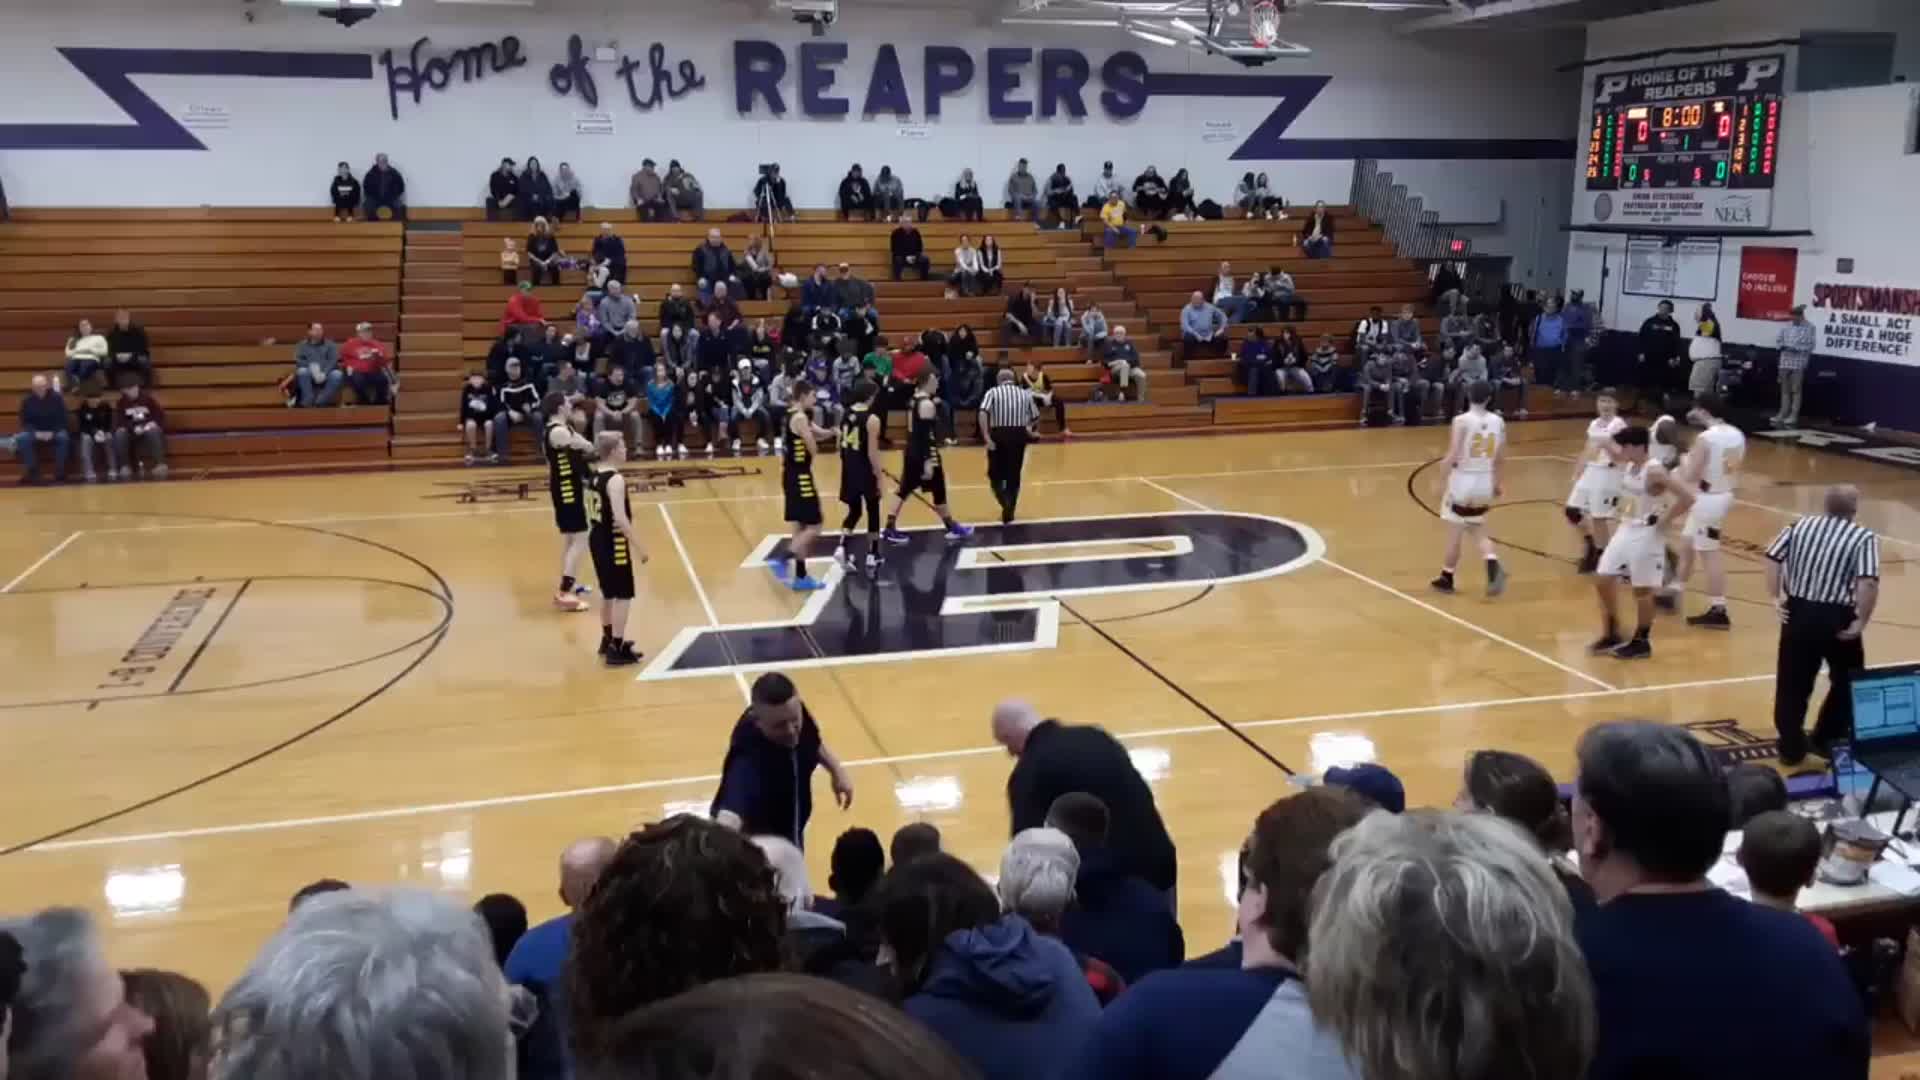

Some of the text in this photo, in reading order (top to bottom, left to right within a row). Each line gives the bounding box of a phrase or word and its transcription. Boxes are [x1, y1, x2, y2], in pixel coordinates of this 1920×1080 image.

[379, 34, 1148, 120] Home of the REAPERS
[1632, 64, 1734, 86] HOME OF THE
[1644, 81, 1716, 99] REAPERS
[1662, 105, 1701, 127] 8:00
[1718, 115, 1730, 137] 0
[1638, 121, 1648, 142] 0
[1628, 164, 1638, 181] 0
[1716, 160, 1726, 179] 0
[1829, 313, 1912, 330] A SMALL ACT
[1824, 324, 1913, 345] MAKES A HUGE
[1825, 336, 1909, 356] DIFFERENCE!
